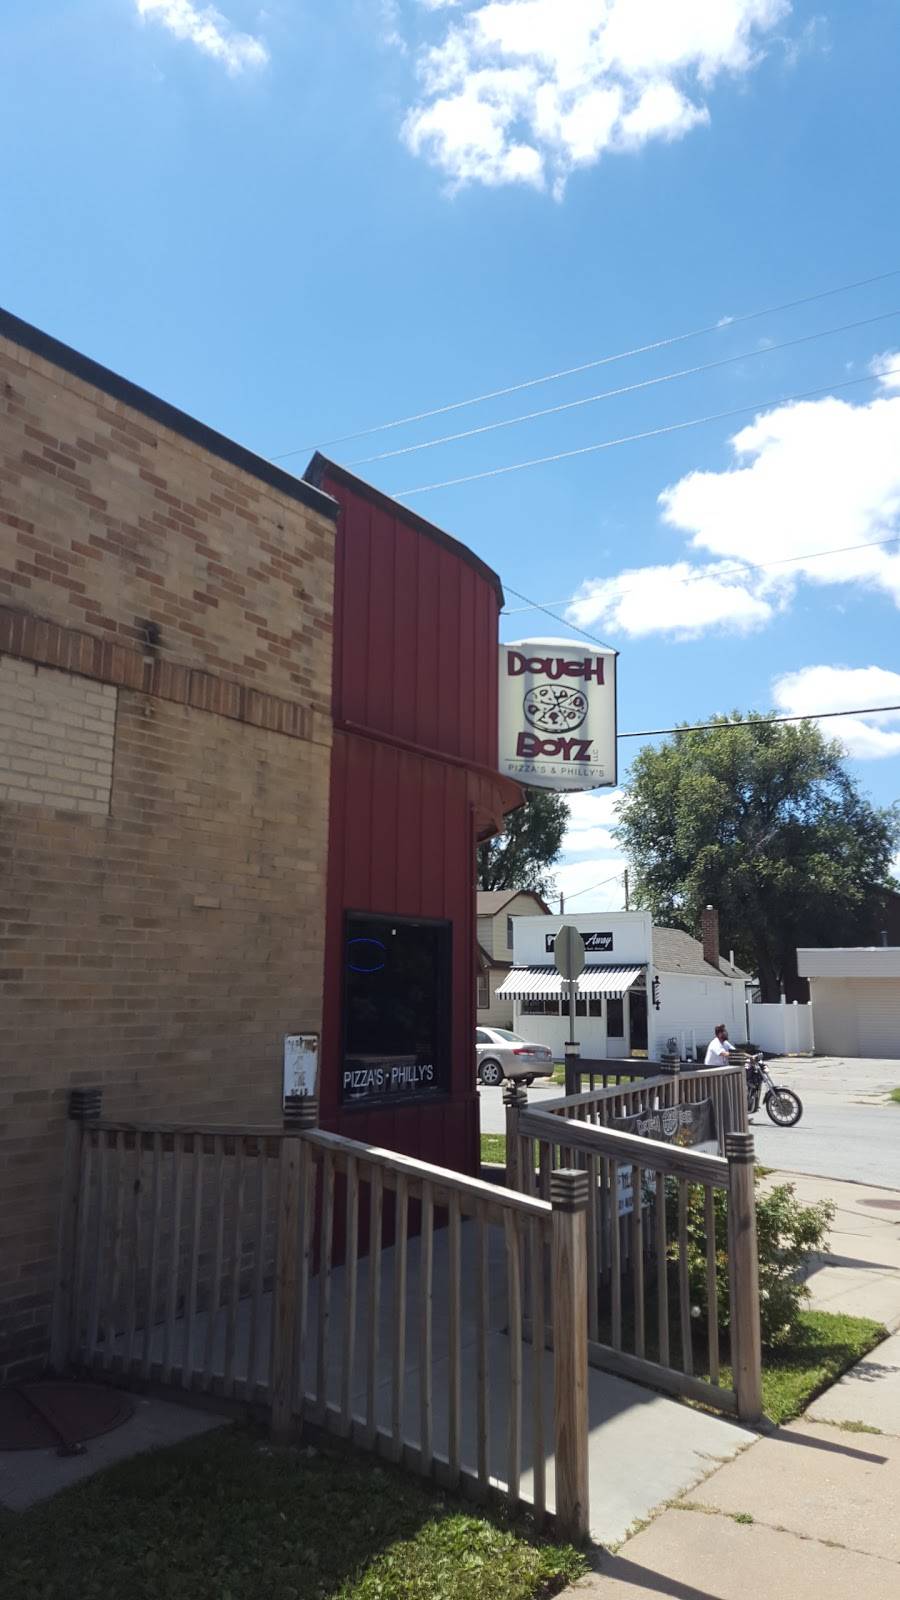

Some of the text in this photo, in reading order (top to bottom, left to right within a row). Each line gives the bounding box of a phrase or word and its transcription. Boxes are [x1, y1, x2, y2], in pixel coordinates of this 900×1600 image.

[507, 650, 605, 685] DOUGH
[516, 732, 594, 762] BOYZ
[508, 764, 546, 773] PIZZA'S
[561, 767, 605, 777] PHILLY'S
[343, 1064, 434, 1089] PIZZA'S PHILLY'S
